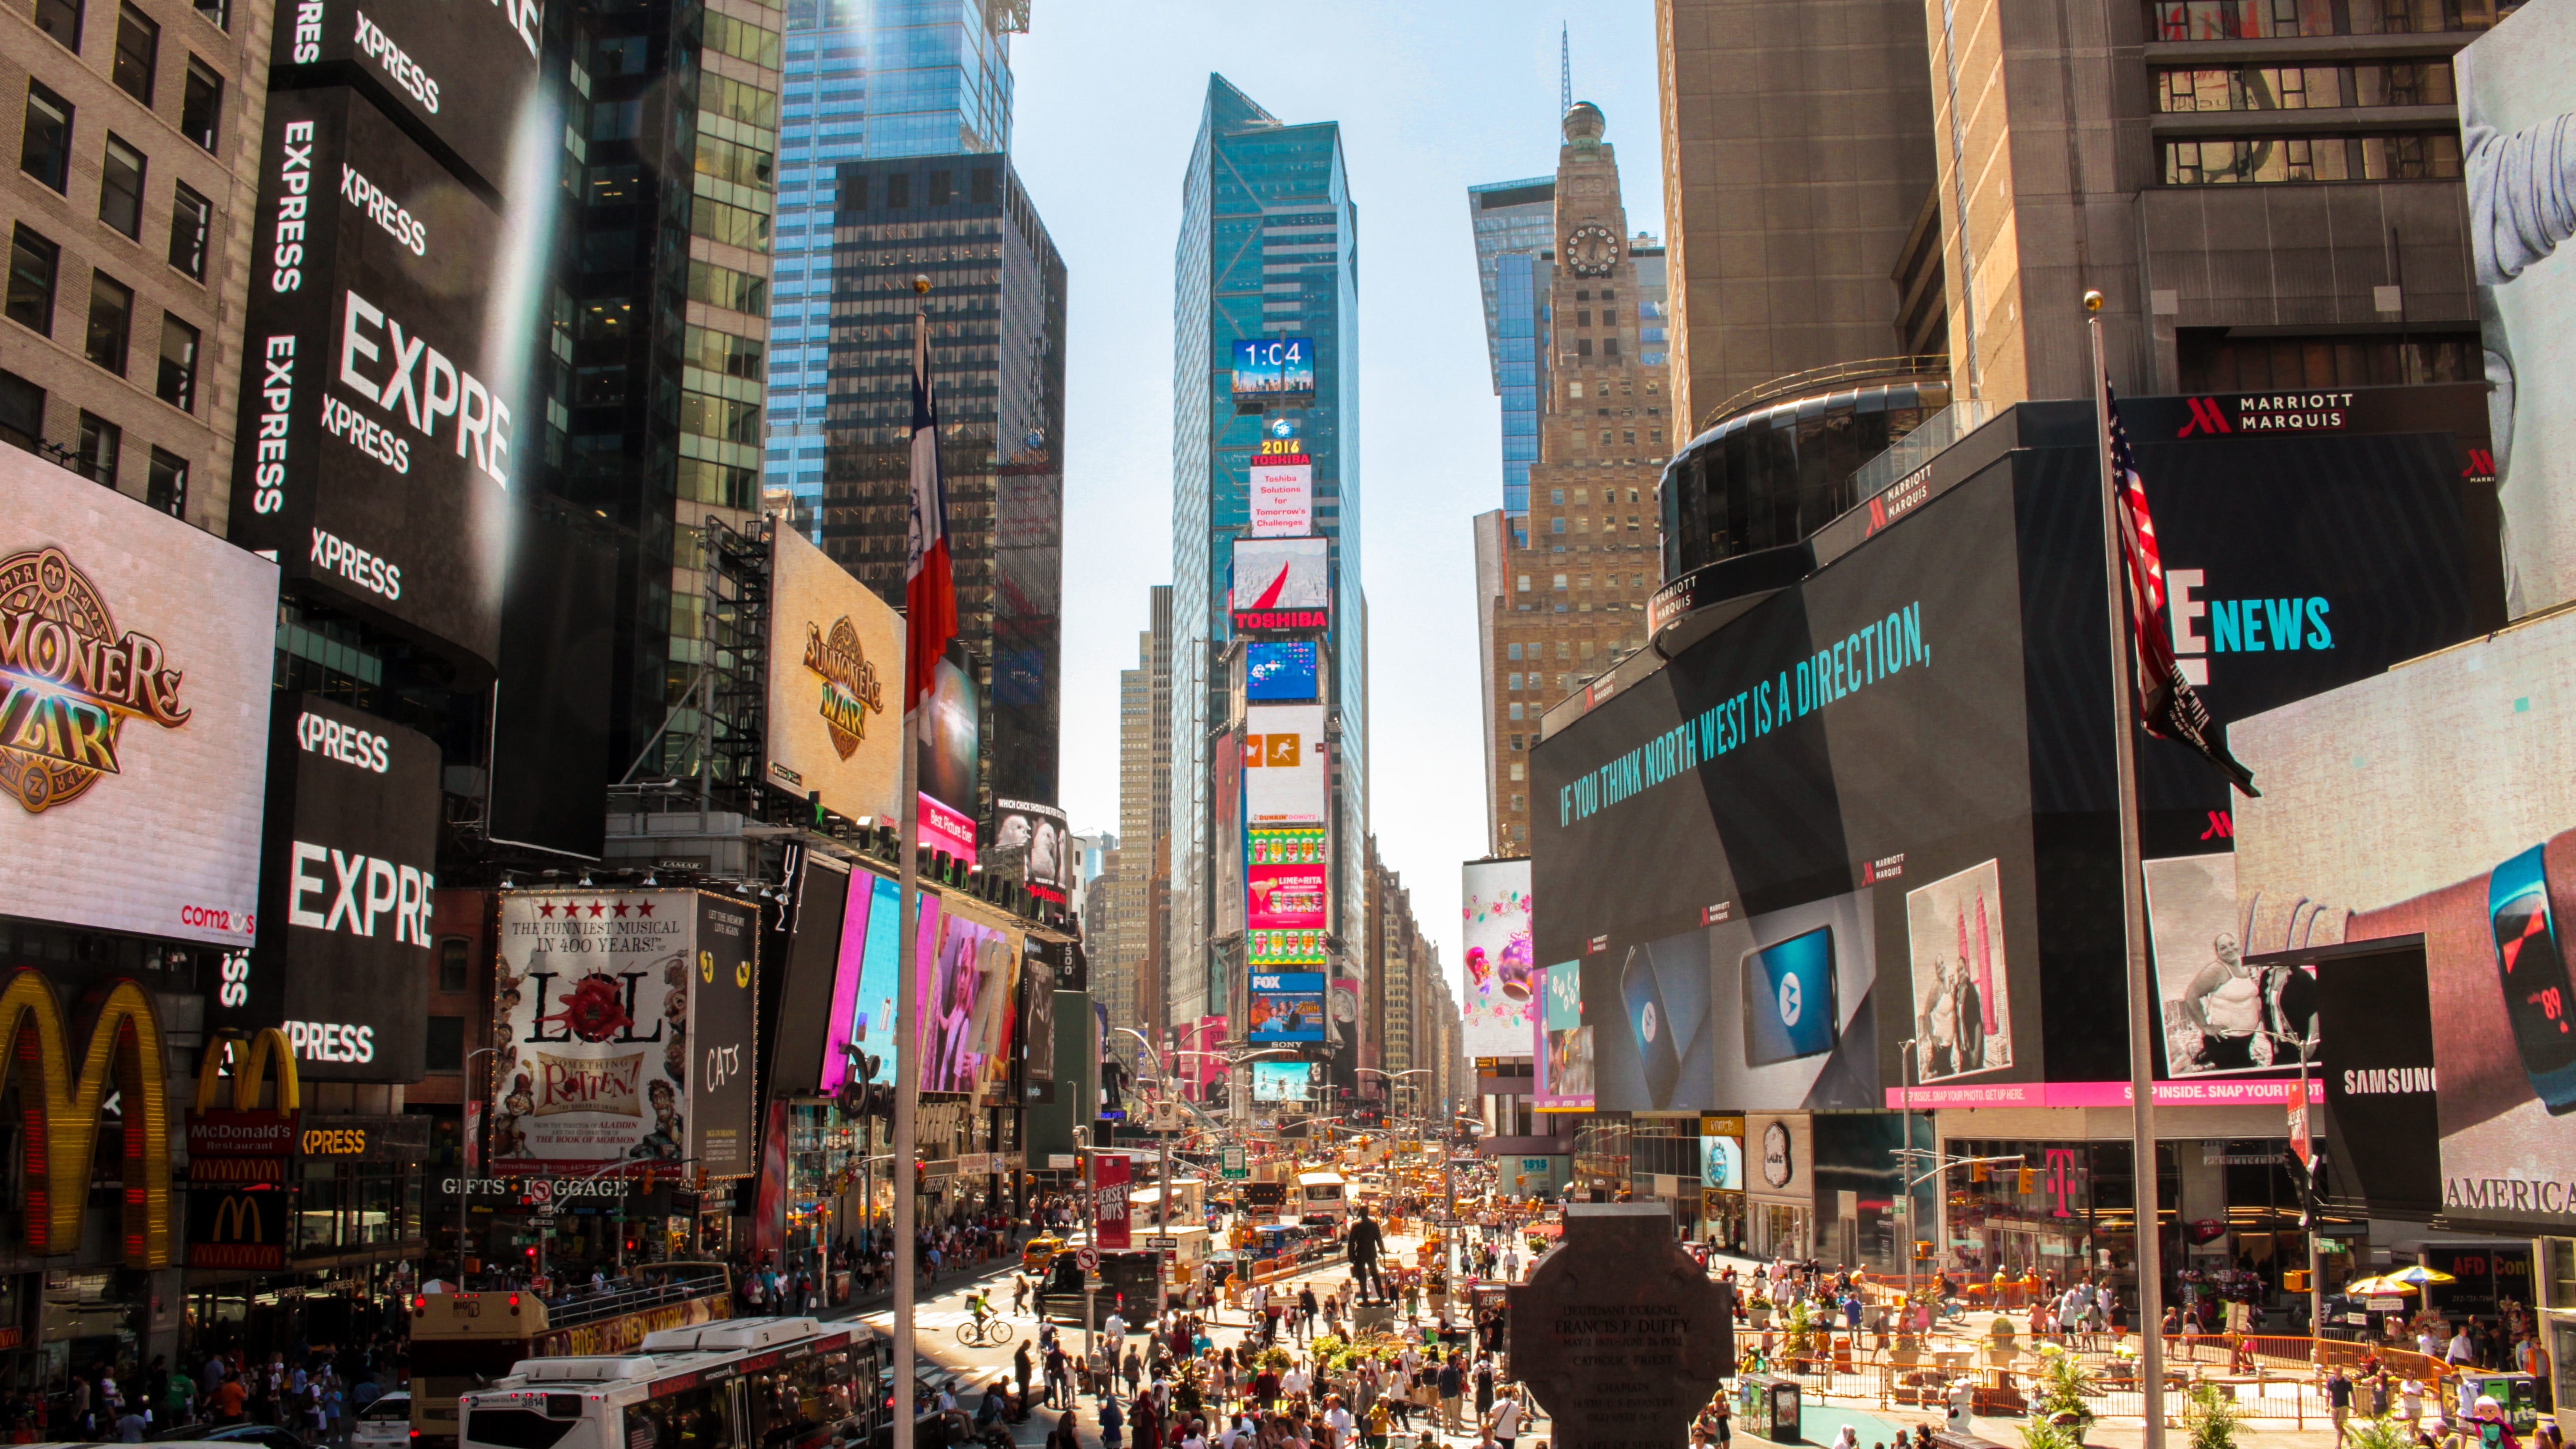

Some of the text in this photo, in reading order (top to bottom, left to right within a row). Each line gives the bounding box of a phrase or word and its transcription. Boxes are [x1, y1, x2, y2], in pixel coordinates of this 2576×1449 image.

[293, 0, 323, 64] RES
[353, 10, 439, 114] XPRESS
[272, 121, 314, 293] EXPRESS
[341, 163, 426, 256] XPRESS
[340, 289, 511, 491] EXPRE
[2241, 394, 2353, 411] MARRIOTT
[253, 335, 295, 514] EXPRESS
[2242, 413, 2342, 429] MARQUIS
[321, 393, 409, 474] XPRESS
[1262, 441, 1300, 454] 2016
[1252, 454, 1310, 465] TOSHIBA
[1887, 465, 1931, 502] MARRIOTT
[1889, 485, 1928, 518] MARQUIS
[1256, 518, 1305, 528] Challenges.
[311, 527, 400, 600] XPRESS
[1656, 575, 1697, 607] MARRIOTT
[1656, 594, 1692, 621] MARQUIS
[1234, 611, 1327, 628] TOSHIBA
[2212, 597, 2333, 652] NEWS
[804, 621, 883, 714] SUMMONERS
[1594, 671, 1616, 690] MARRIOTT
[1594, 684, 1614, 702] MARQUIS
[820, 682, 865, 740] WAR
[1561, 601, 1930, 827] IF YOU THINK NORTH WEST IS A DIRECTION,
[998, 799, 1015, 809] WHICH
[1875, 854, 1904, 868] MARRIOTT
[1876, 866, 1901, 880] MARQUIS
[289, 840, 434, 949] EXPRE
[1709, 901, 1730, 913] MARRIOTT
[717, 911, 726, 922] THE
[1709, 912, 1728, 922] MARQUIS
[512, 921, 680, 935] THE FUNNIEST MUSICAL
[537, 938, 558, 953] IN
[560, 938, 591, 953] 400
[1253, 976, 1281, 989] FOX
[524, 972, 661, 1043] LOL
[553, 1059, 627, 1069] SOMETHING
[707, 1043, 739, 1093] CATS
[1914, 1088, 2025, 1101] INSIDE. SNAP YOUR PHOTO. GET UP HERE.
[2159, 1084, 2281, 1098] INSIDE. SNAP YOUR
[191, 1124, 291, 1139] McDonald's
[596, 1136, 636, 1144] MORMON
[207, 1142, 274, 1150] Restaurant
[1522, 1159, 1547, 1169] 1515
[523, 1179, 629, 1197] LGGAGE
[1096, 1183, 1129, 1205] JERSEY
[471, 1205, 494, 1213] Nikon
[1101, 1202, 1124, 1221] BOYS
[2453, 1257, 2485, 1275] AFD
[323, 1278, 355, 1293] EXPRESS
[453, 1302, 468, 1310] BIG
[1563, 1305, 1679, 1316] LIEUTENANT COLONEL
[622, 1307, 683, 1346] NEW YORK
[1555, 1320, 1617, 1334] FRANCIS
[1638, 1318, 1691, 1333] DUFFY
[1572, 1355, 1674, 1366] CATHOLIC PRIEST
[652, 1374, 697, 1398] BLINDSPOT
[522, 1398, 544, 1407] 3814
